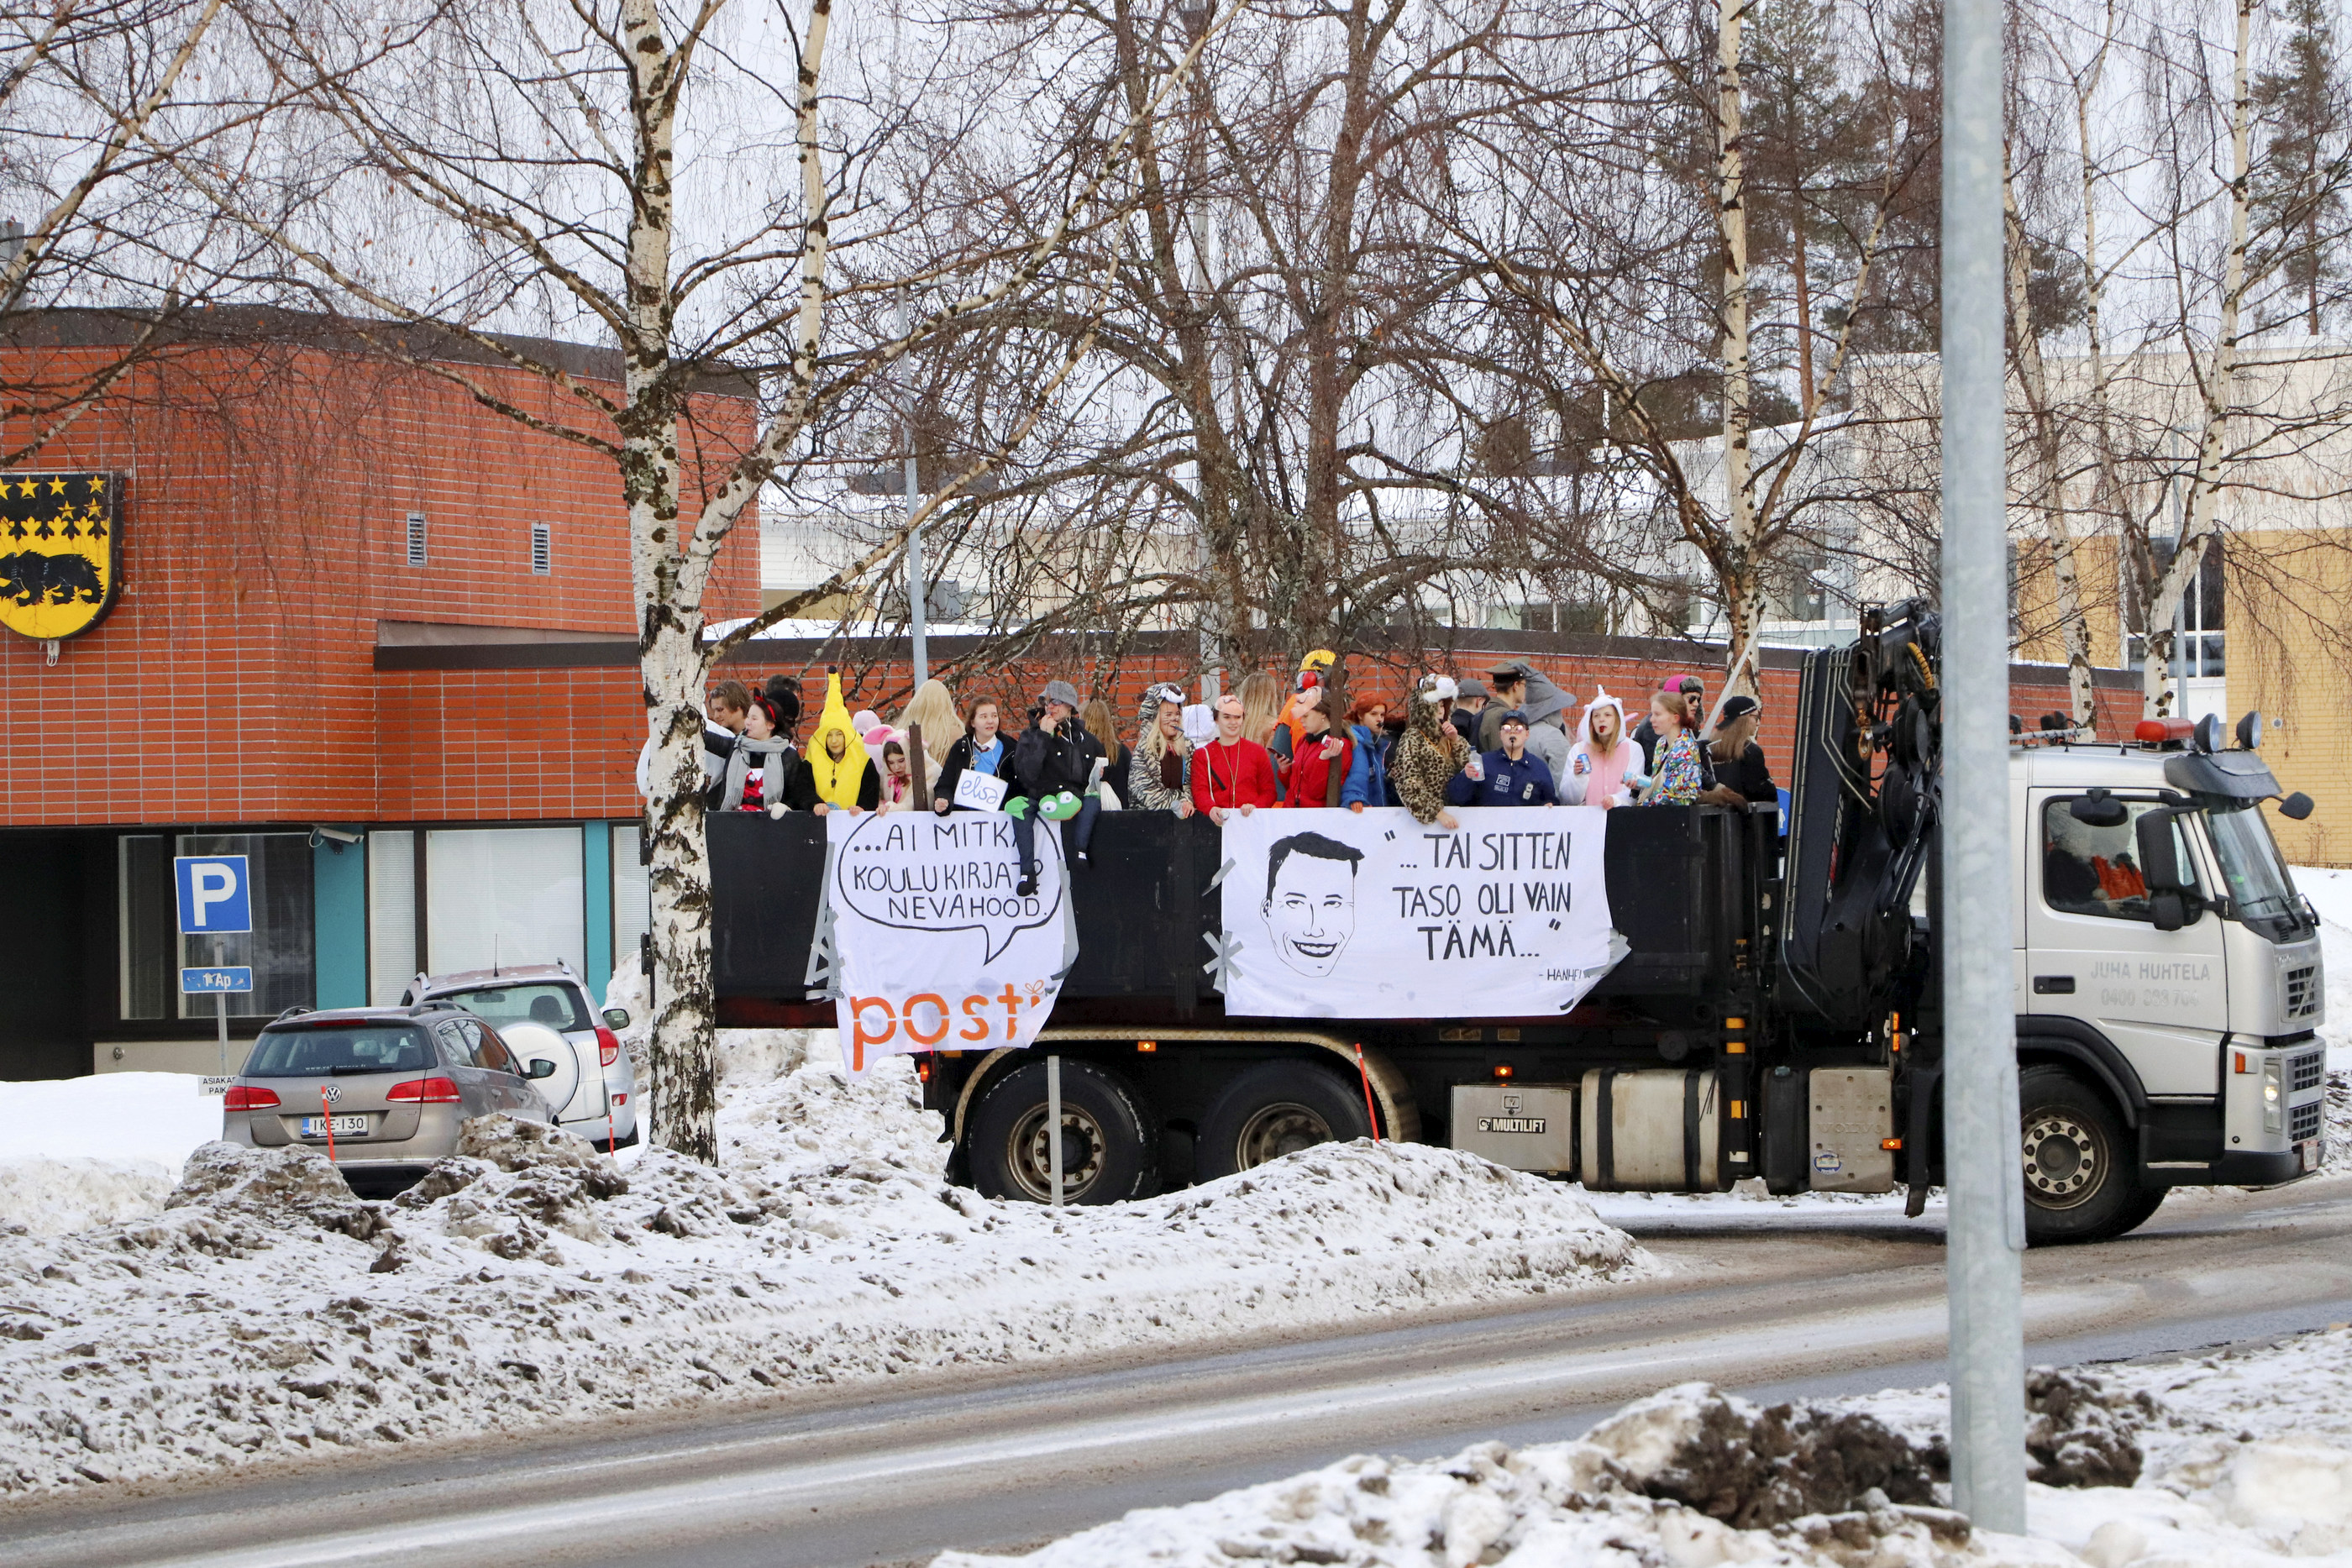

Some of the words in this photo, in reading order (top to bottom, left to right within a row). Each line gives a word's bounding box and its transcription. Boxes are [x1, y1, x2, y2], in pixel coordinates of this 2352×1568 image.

[961, 775, 999, 804] elisa
[933, 820, 1016, 851] MITK
[1479, 831, 1572, 870] SITTEN
[191, 863, 237, 926] P
[1392, 884, 1462, 918] TASO
[1478, 883, 1515, 915] OLI
[1523, 882, 1572, 913] VAIN
[2091, 962, 2131, 979] JUHA
[2139, 962, 2211, 981] HUHTELA
[1492, 1118, 1545, 1133] MULTILIFT
